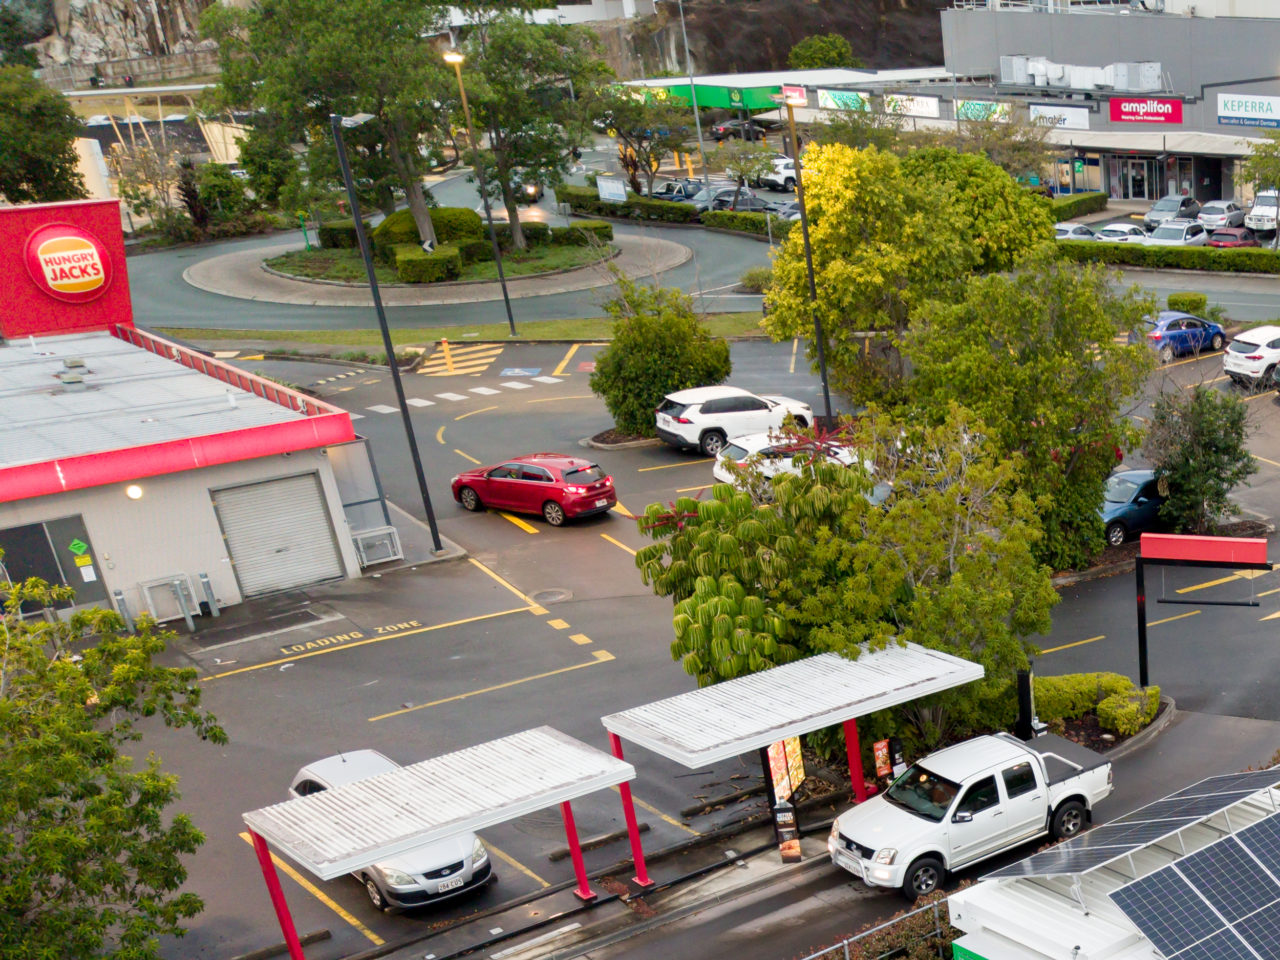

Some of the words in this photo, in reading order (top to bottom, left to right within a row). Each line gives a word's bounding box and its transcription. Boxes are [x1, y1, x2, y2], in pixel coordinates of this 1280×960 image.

[1121, 100, 1172, 114] amplifon
[1223, 100, 1273, 113] KEPERRA
[43, 252, 95, 267] HUNGRY
[280, 631, 365, 655] LOADING
[374, 620, 423, 634] ZONE
